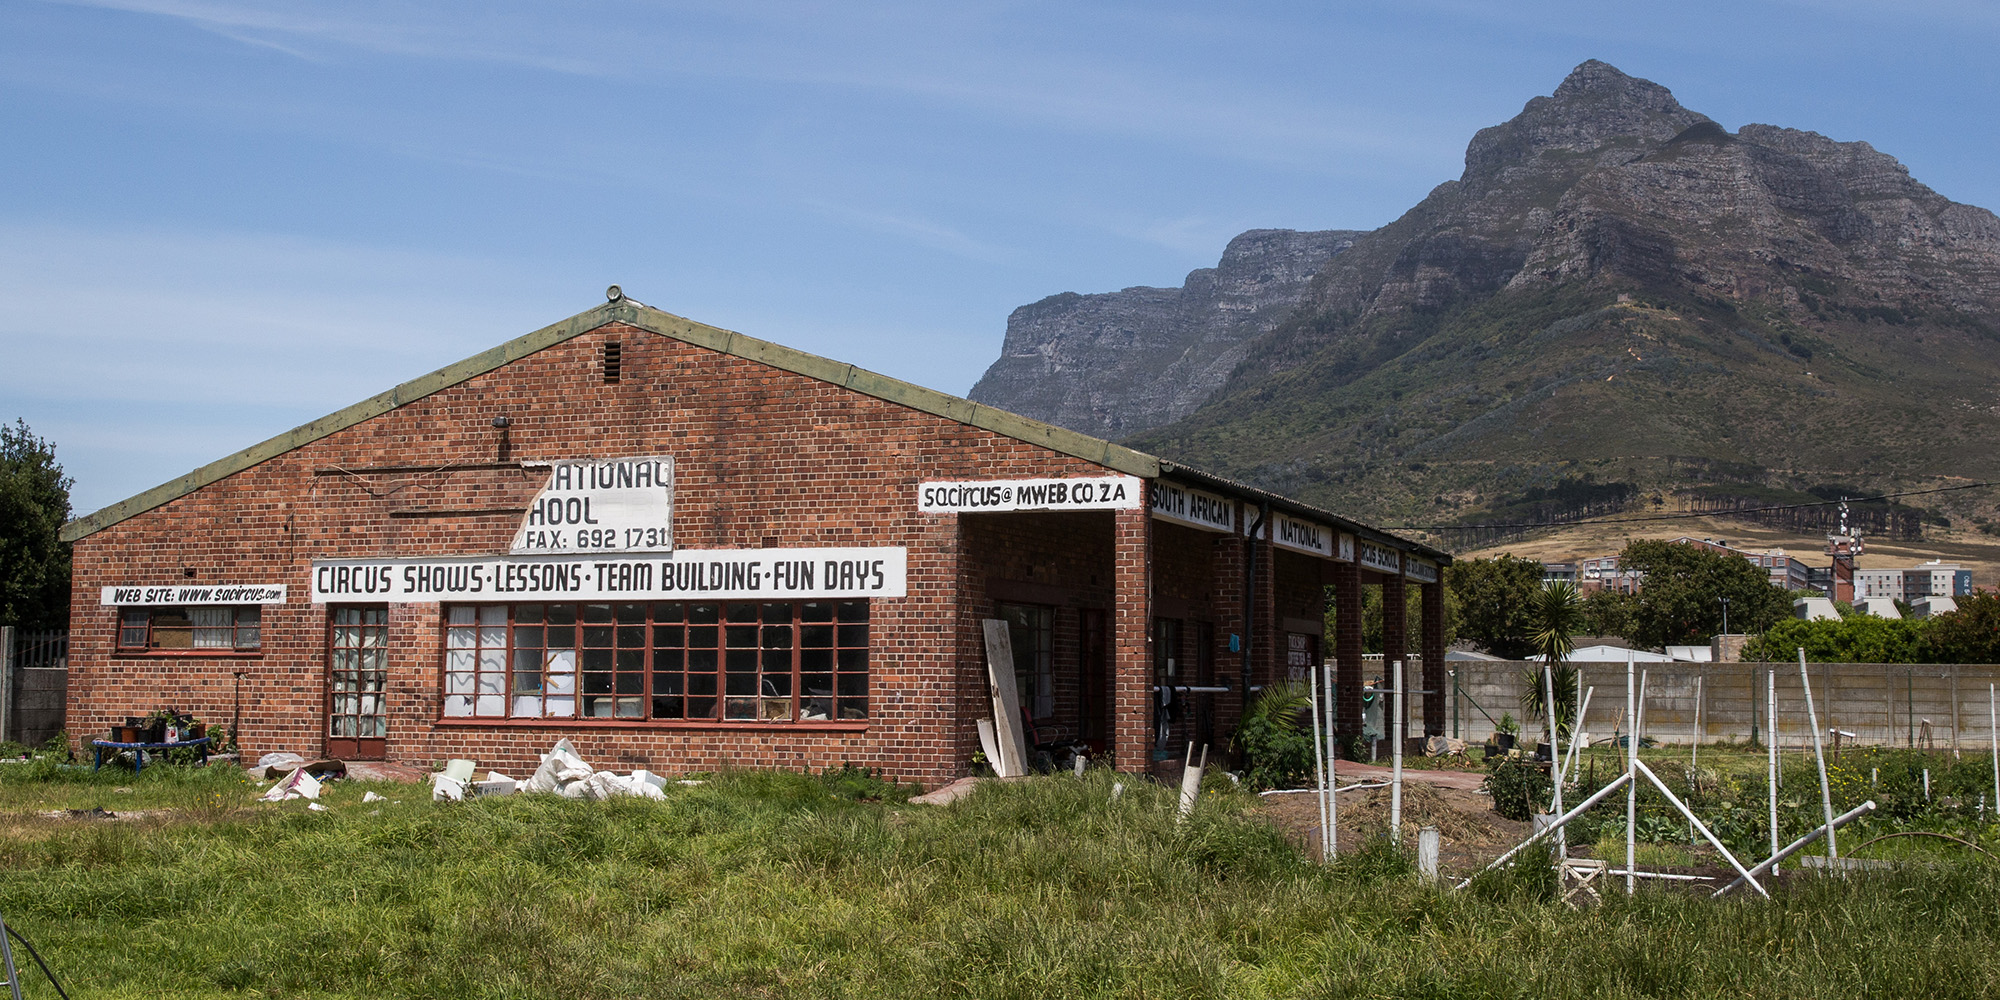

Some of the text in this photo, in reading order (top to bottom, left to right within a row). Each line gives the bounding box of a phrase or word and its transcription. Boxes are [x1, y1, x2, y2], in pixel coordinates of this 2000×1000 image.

[548, 460, 668, 490] ATIONAL
[1016, 482, 1126, 505] MWEB.CO.ZA
[1152, 482, 1230, 527] SOUTH AFRICAN
[526, 527, 667, 550] FAX: 692 1731
[1280, 518, 1322, 550] NATIONAL
[1377, 546, 1398, 570] SCHOOL
[317, 566, 393, 594] CIRCUS
[594, 562, 653, 592] TEAM
[661, 561, 761, 591] BUILDING
[824, 560, 884, 590] DAYS
[113, 588, 142, 603] WEB
[145, 588, 175, 603] SITE:
